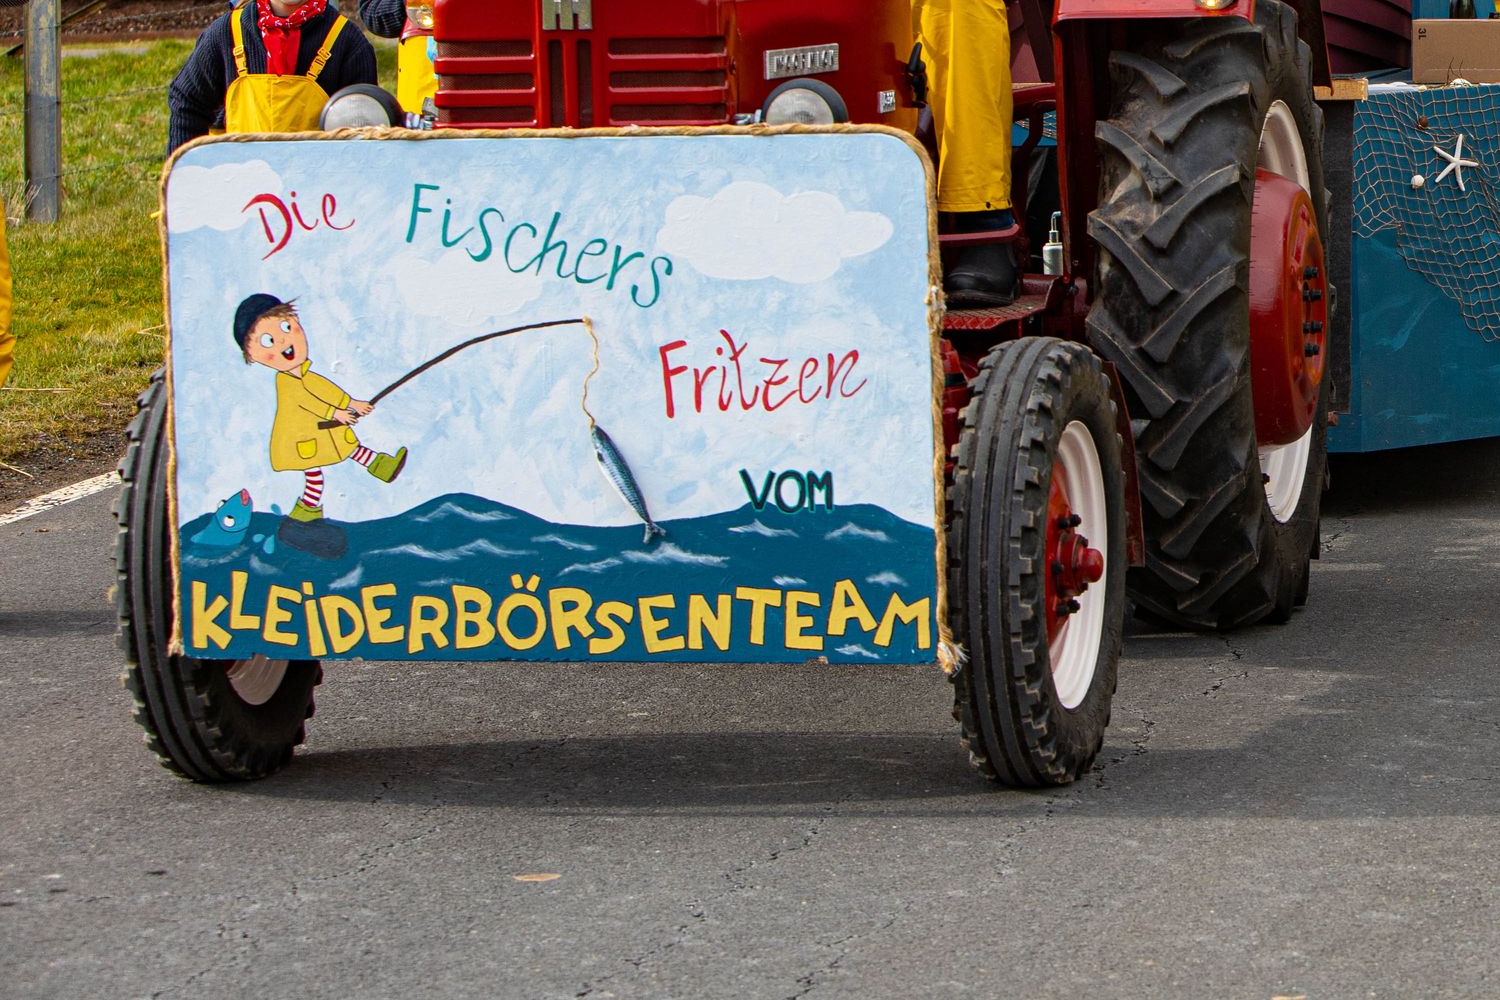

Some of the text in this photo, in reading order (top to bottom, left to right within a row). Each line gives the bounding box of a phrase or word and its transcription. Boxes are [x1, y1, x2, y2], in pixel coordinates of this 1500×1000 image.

[1418, 27, 1427, 40] 3L
[241, 183, 673, 308] Die Fischers
[659, 329, 867, 419] Fritzen
